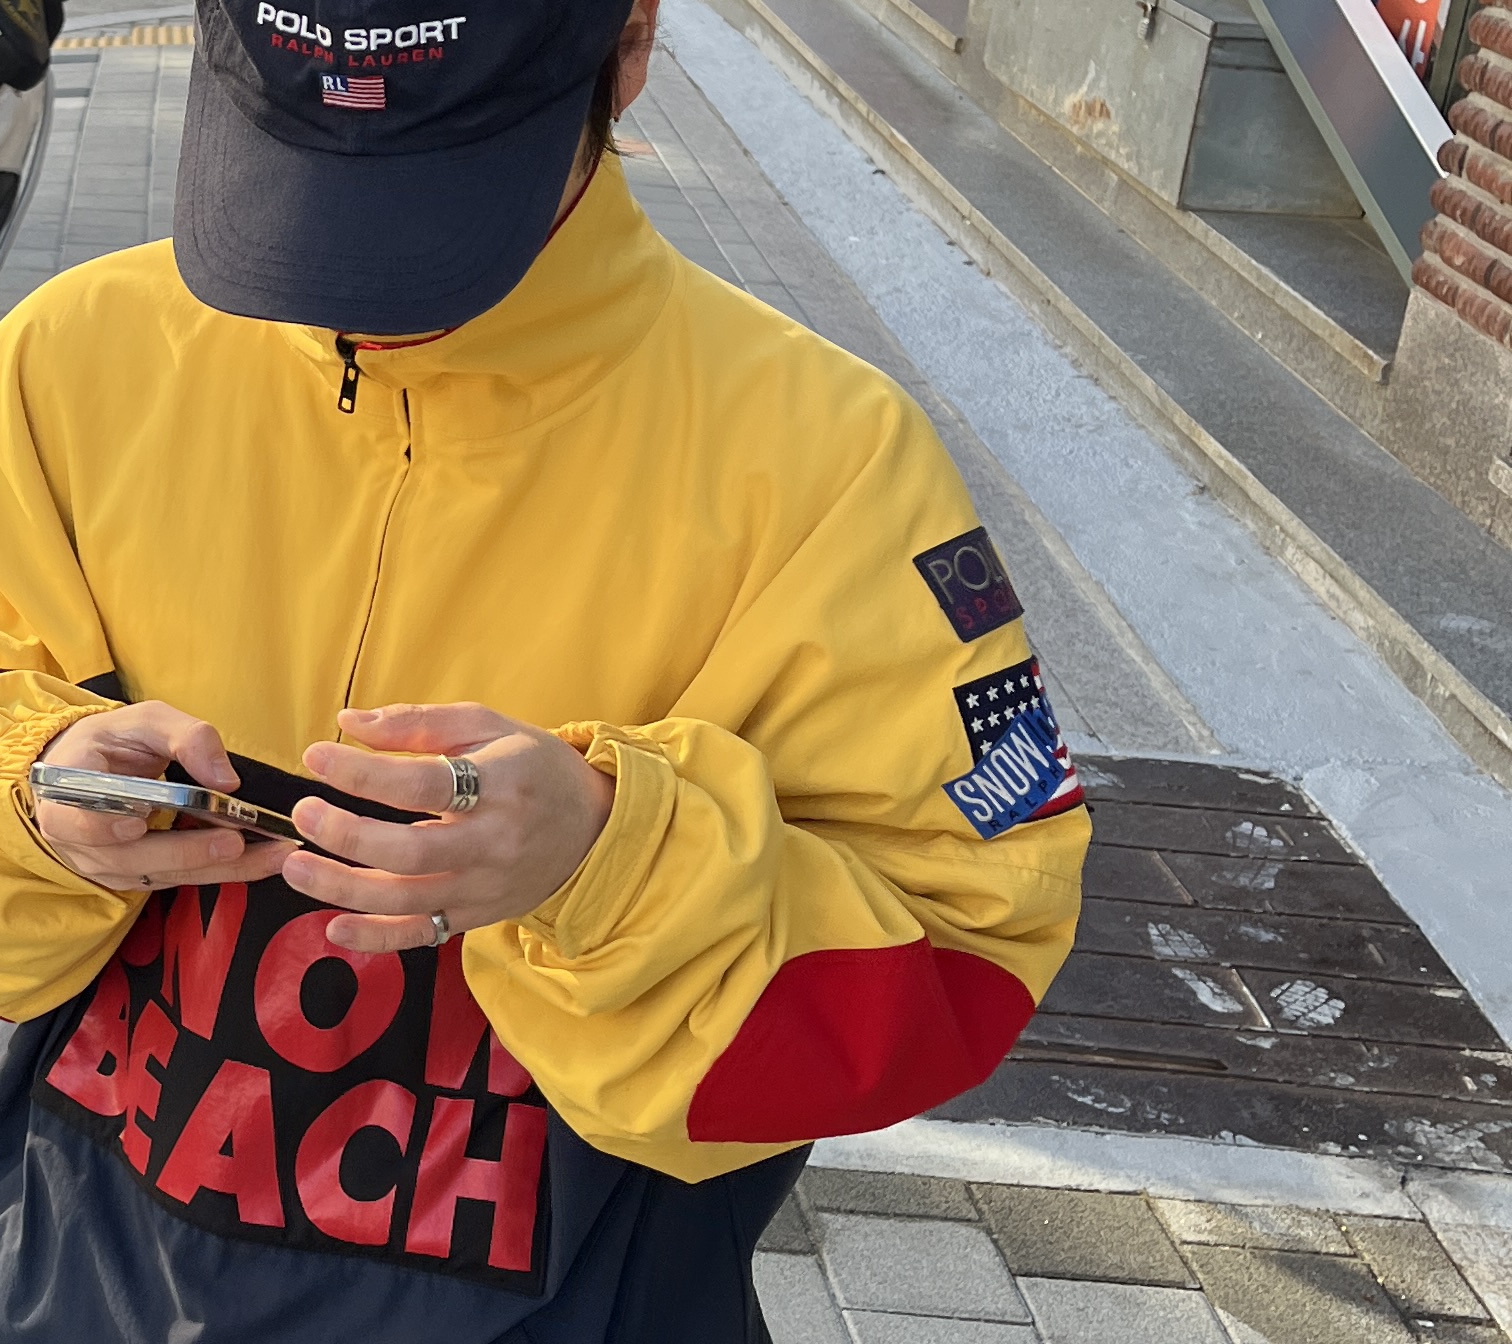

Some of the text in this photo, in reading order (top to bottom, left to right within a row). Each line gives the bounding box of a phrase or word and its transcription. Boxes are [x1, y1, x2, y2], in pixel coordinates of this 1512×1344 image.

[257, 1, 467, 51] POLO SPORT
[271, 33, 444, 67] RALPH LAUREN
[322, 75, 347, 92] RL
[954, 722, 1049, 822] SNOW
